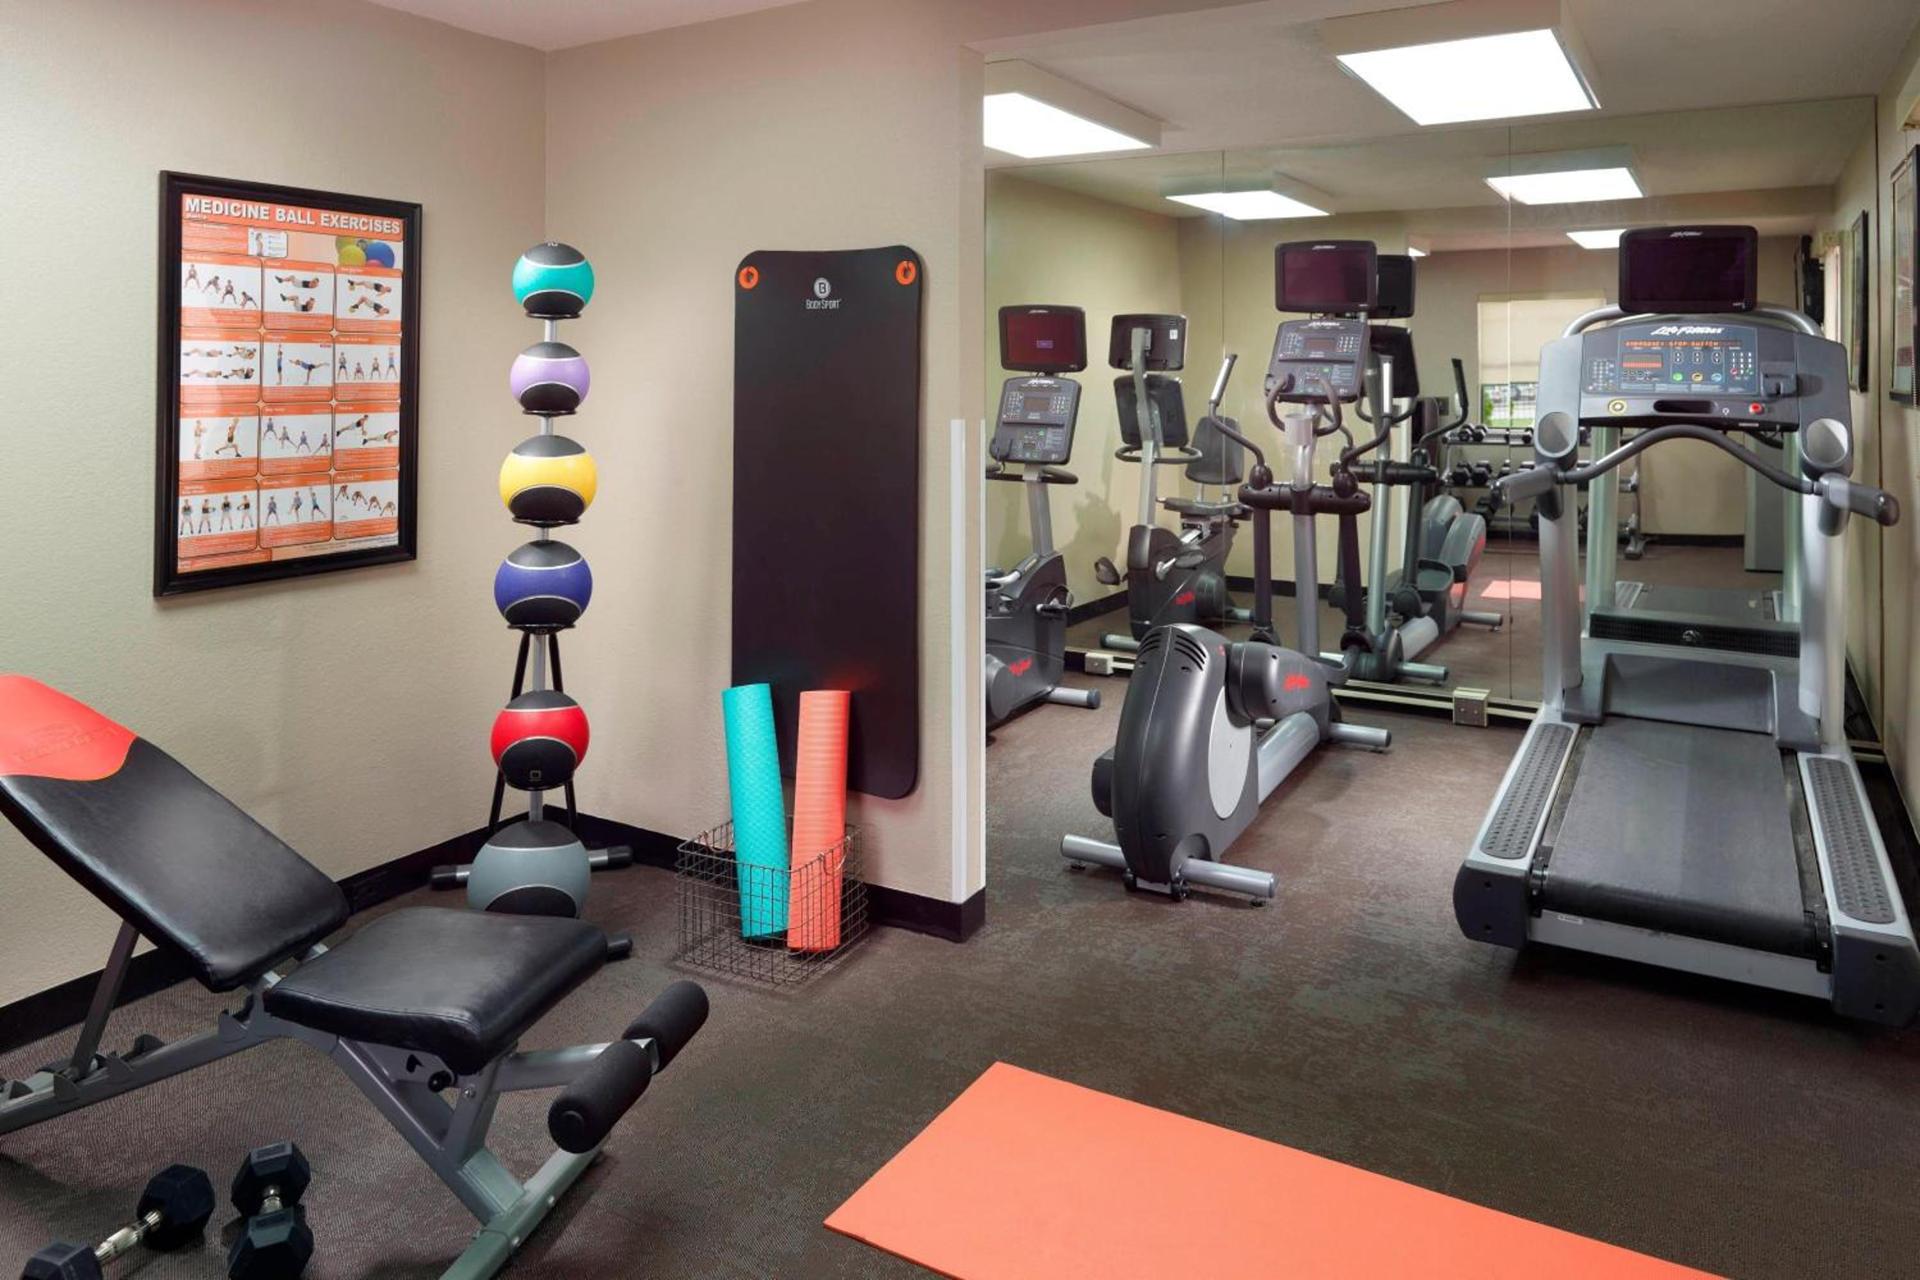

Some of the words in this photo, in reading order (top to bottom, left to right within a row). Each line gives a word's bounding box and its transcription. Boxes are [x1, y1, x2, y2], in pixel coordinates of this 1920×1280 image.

[184, 198, 269, 221] MEDICINE
[275, 208, 315, 226] BALL
[320, 213, 401, 235] EXERCISES
